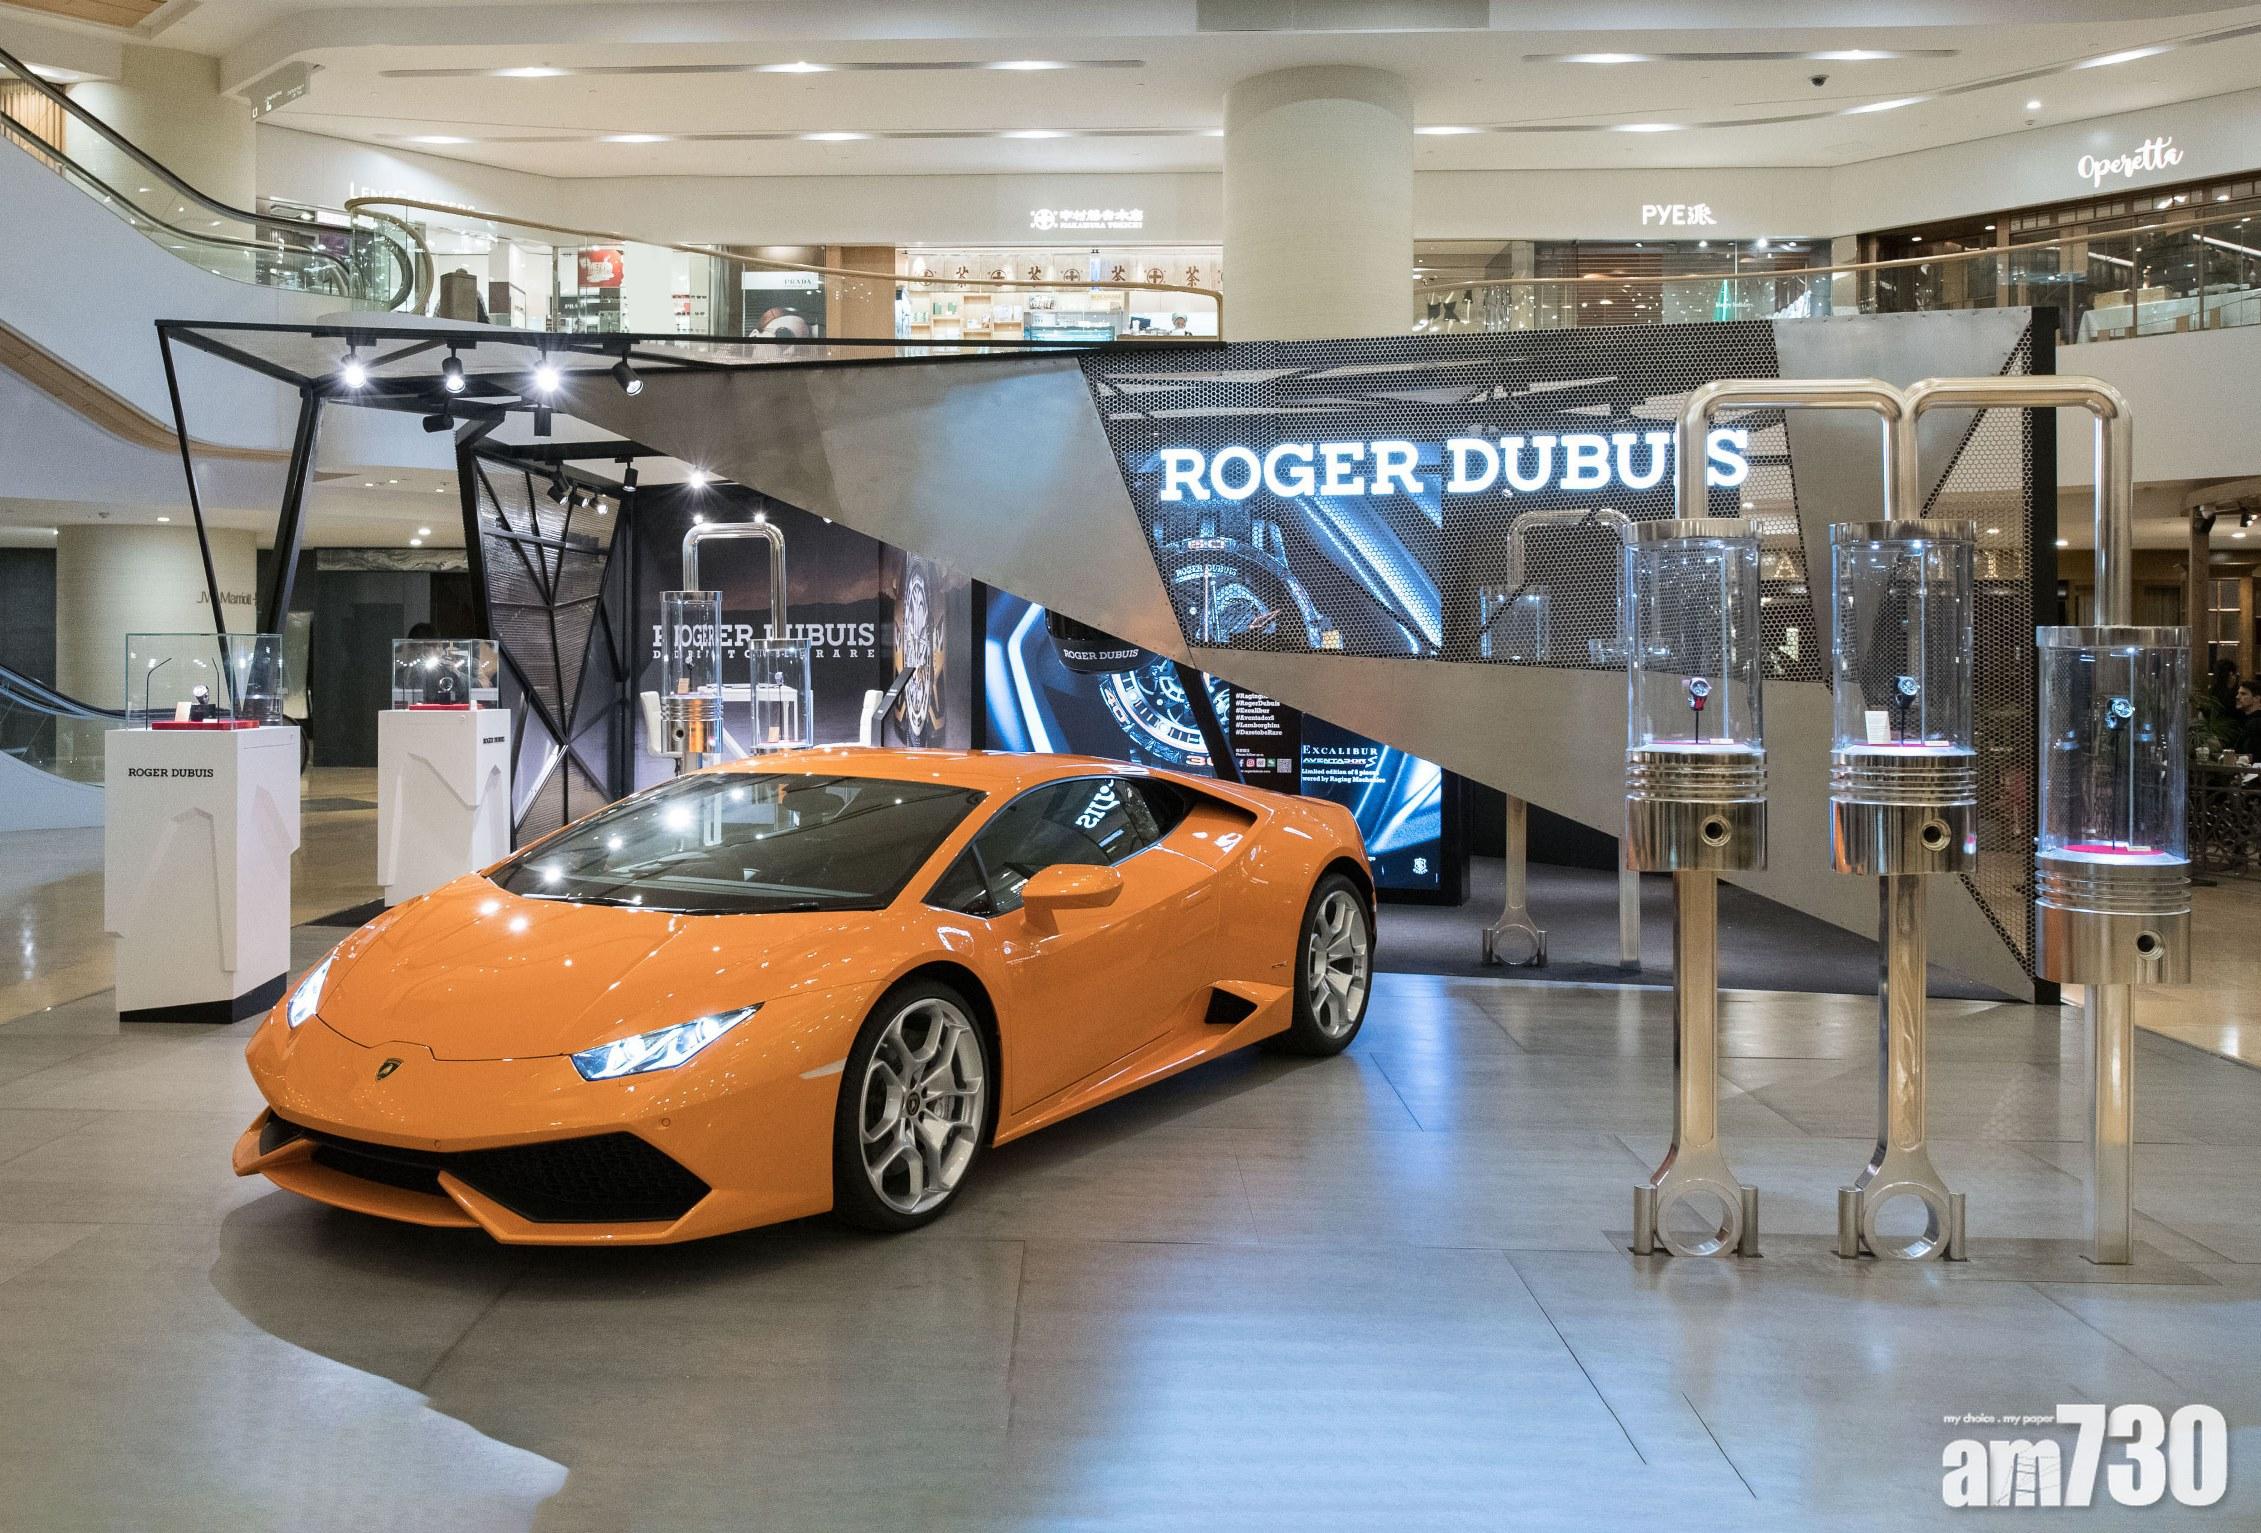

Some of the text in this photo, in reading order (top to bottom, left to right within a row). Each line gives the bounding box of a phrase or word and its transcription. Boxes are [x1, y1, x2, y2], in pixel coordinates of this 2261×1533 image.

[2078, 136, 2184, 188] Operetta
[1160, 428, 1749, 501] ROGER DUBUS
[816, 649, 875, 659] RARE
[1063, 649, 1139, 660] ROGER DUBUIS
[1302, 745, 1378, 755] EXCALIBUR
[128, 768, 214, 778] ROGER DUBUIS
